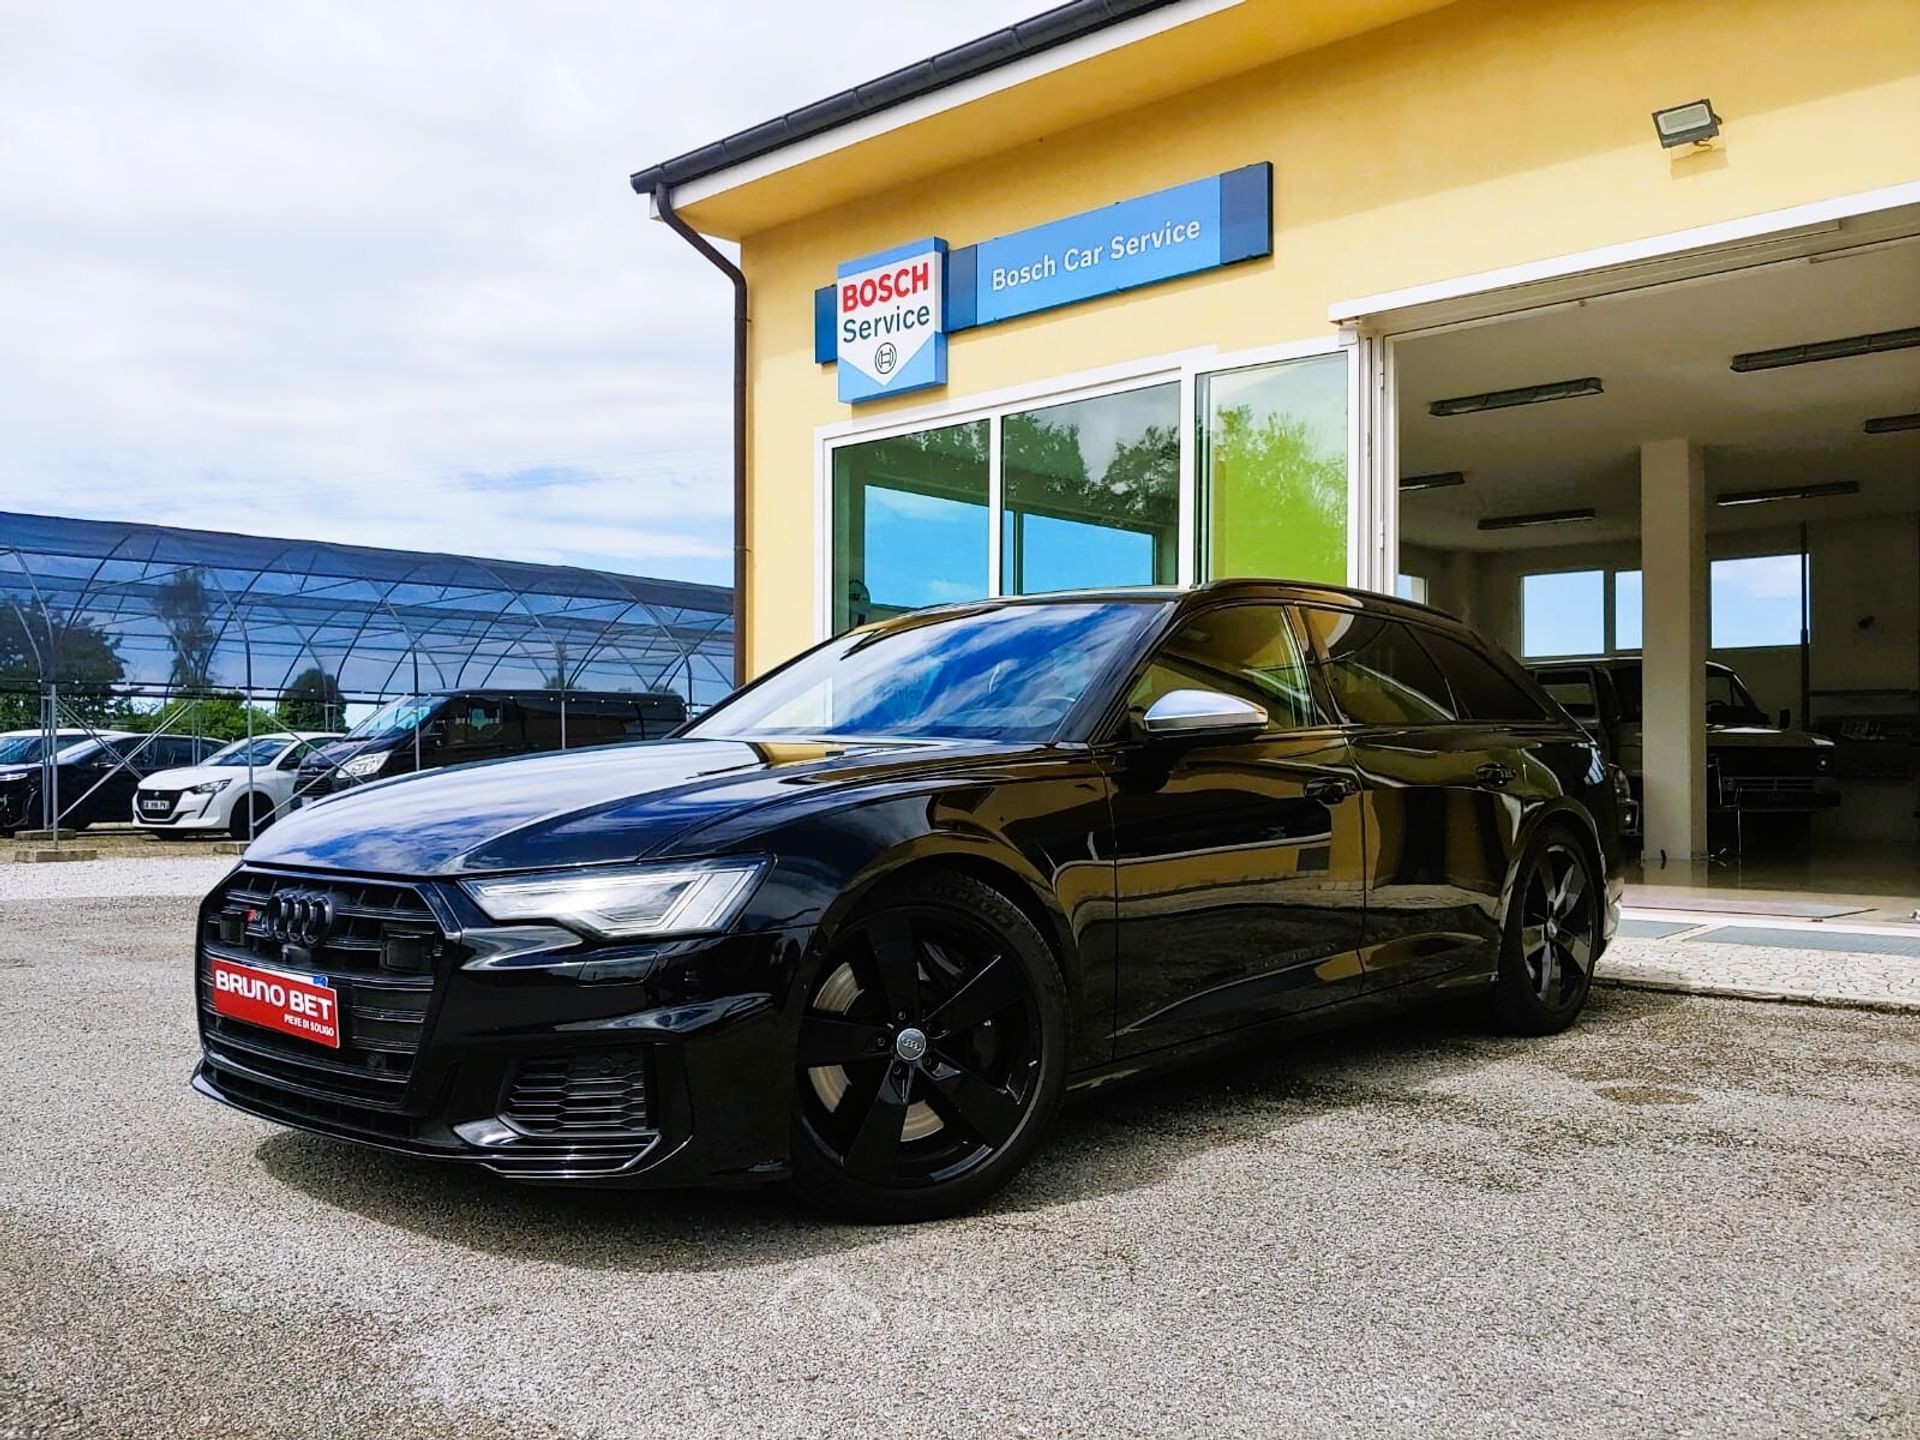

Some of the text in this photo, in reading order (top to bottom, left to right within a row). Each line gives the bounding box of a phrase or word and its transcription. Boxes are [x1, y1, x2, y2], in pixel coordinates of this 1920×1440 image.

[991, 218, 1202, 292] Bosch Car Service
[842, 261, 929, 313] BOSCH
[842, 303, 930, 344] Service
[215, 969, 333, 1020] BRUNO BET
